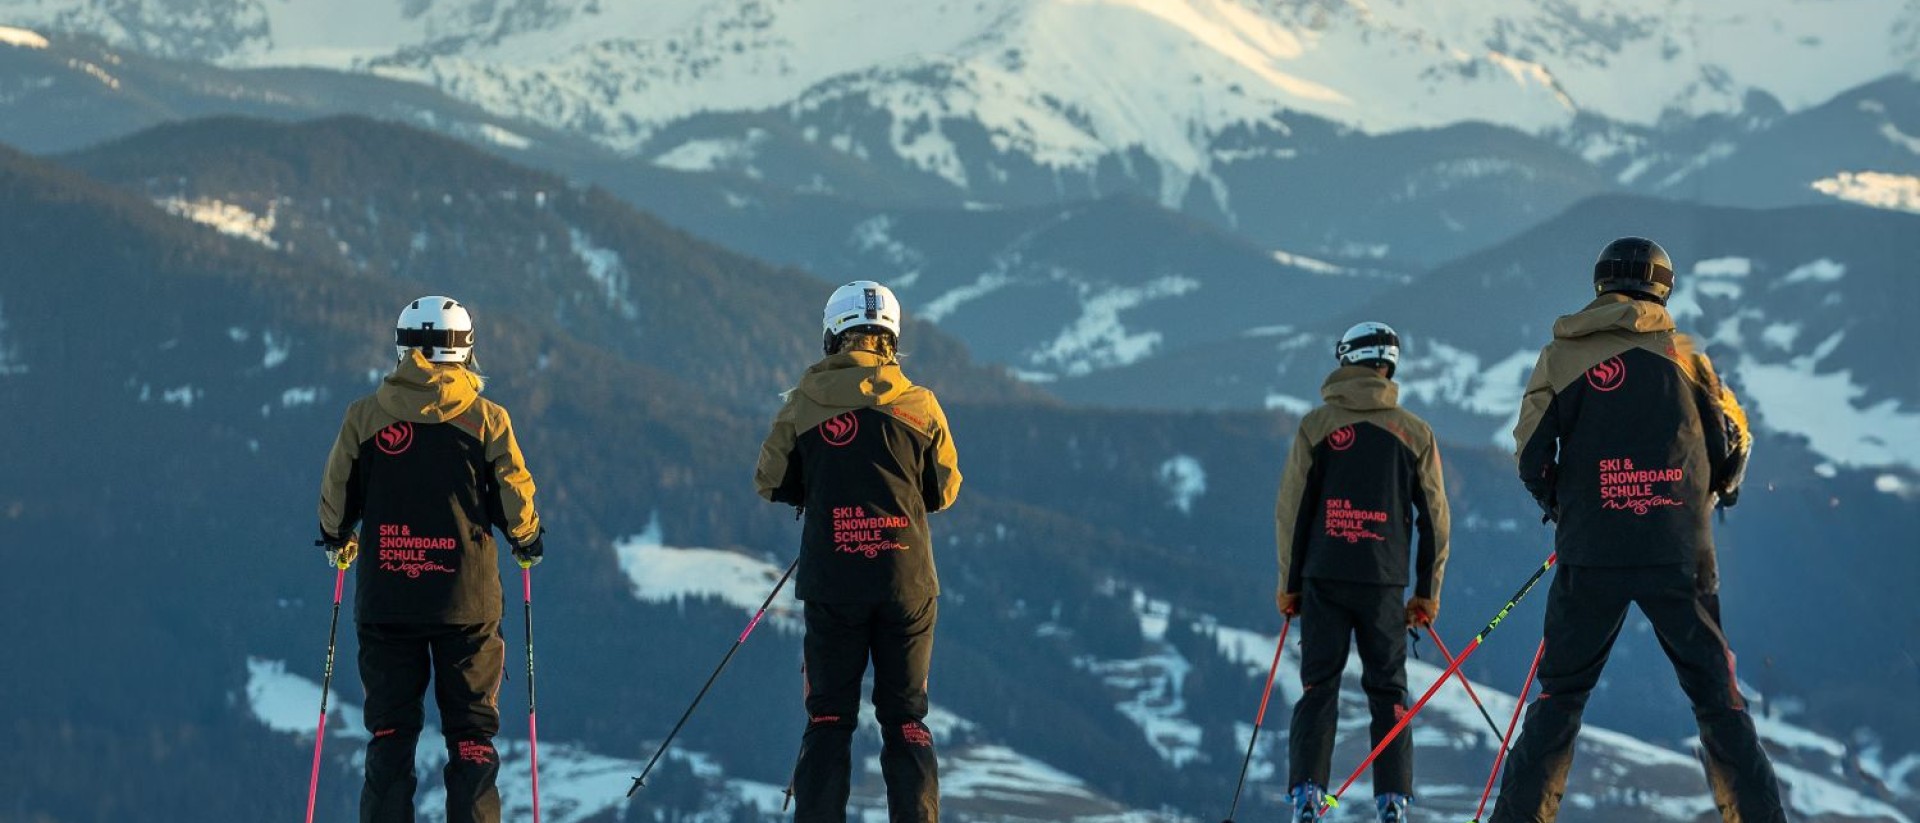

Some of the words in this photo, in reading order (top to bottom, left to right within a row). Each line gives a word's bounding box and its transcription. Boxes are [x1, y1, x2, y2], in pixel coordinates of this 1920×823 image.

[1600, 459, 1619, 472] SKI
[1623, 458, 1633, 470] &
[1600, 468, 1683, 485] SNOWBOARD
[1600, 484, 1653, 499] SCHULE
[833, 507, 853, 519] SKI
[855, 506, 865, 518] &
[1326, 509, 1387, 522] SNOWBOARD
[833, 516, 909, 531] SNOWBOARD
[1325, 519, 1363, 530] SCHULE
[379, 525, 399, 536] SKI
[401, 525, 411, 536] &
[833, 530, 883, 543] SCHULE
[379, 536, 457, 550] SNOWBOARD
[379, 549, 427, 561] SCHULE
[1489, 601, 1515, 629] LEKI
